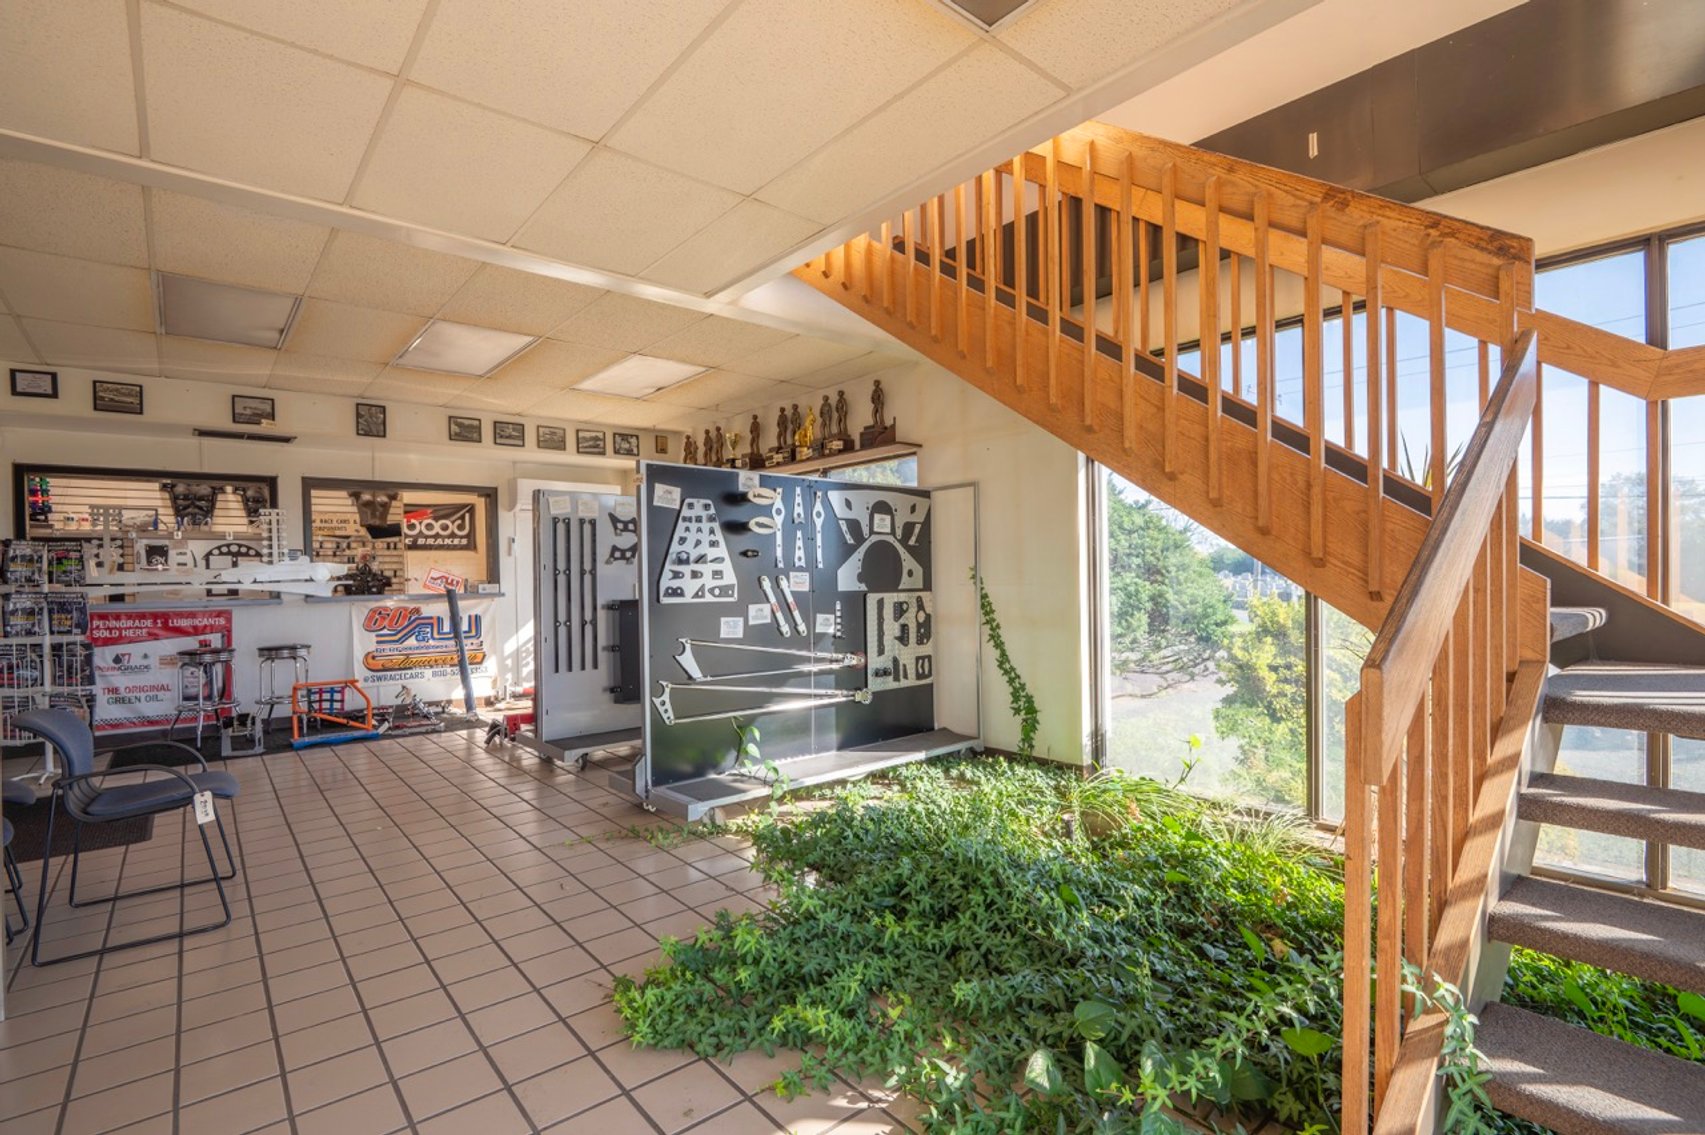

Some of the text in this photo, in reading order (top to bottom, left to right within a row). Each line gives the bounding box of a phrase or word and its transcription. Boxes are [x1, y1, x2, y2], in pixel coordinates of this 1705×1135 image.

[417, 537, 468, 545] BRAKES
[92, 619, 153, 629] PENNGRADE
[168, 617, 225, 627] LUBRICANTS
[92, 628, 149, 638] SOLD HERE
[363, 671, 425, 683] @SWRACECARS
[102, 684, 172, 696] THE ORIGINAL
[107, 696, 140, 706] GREEN
